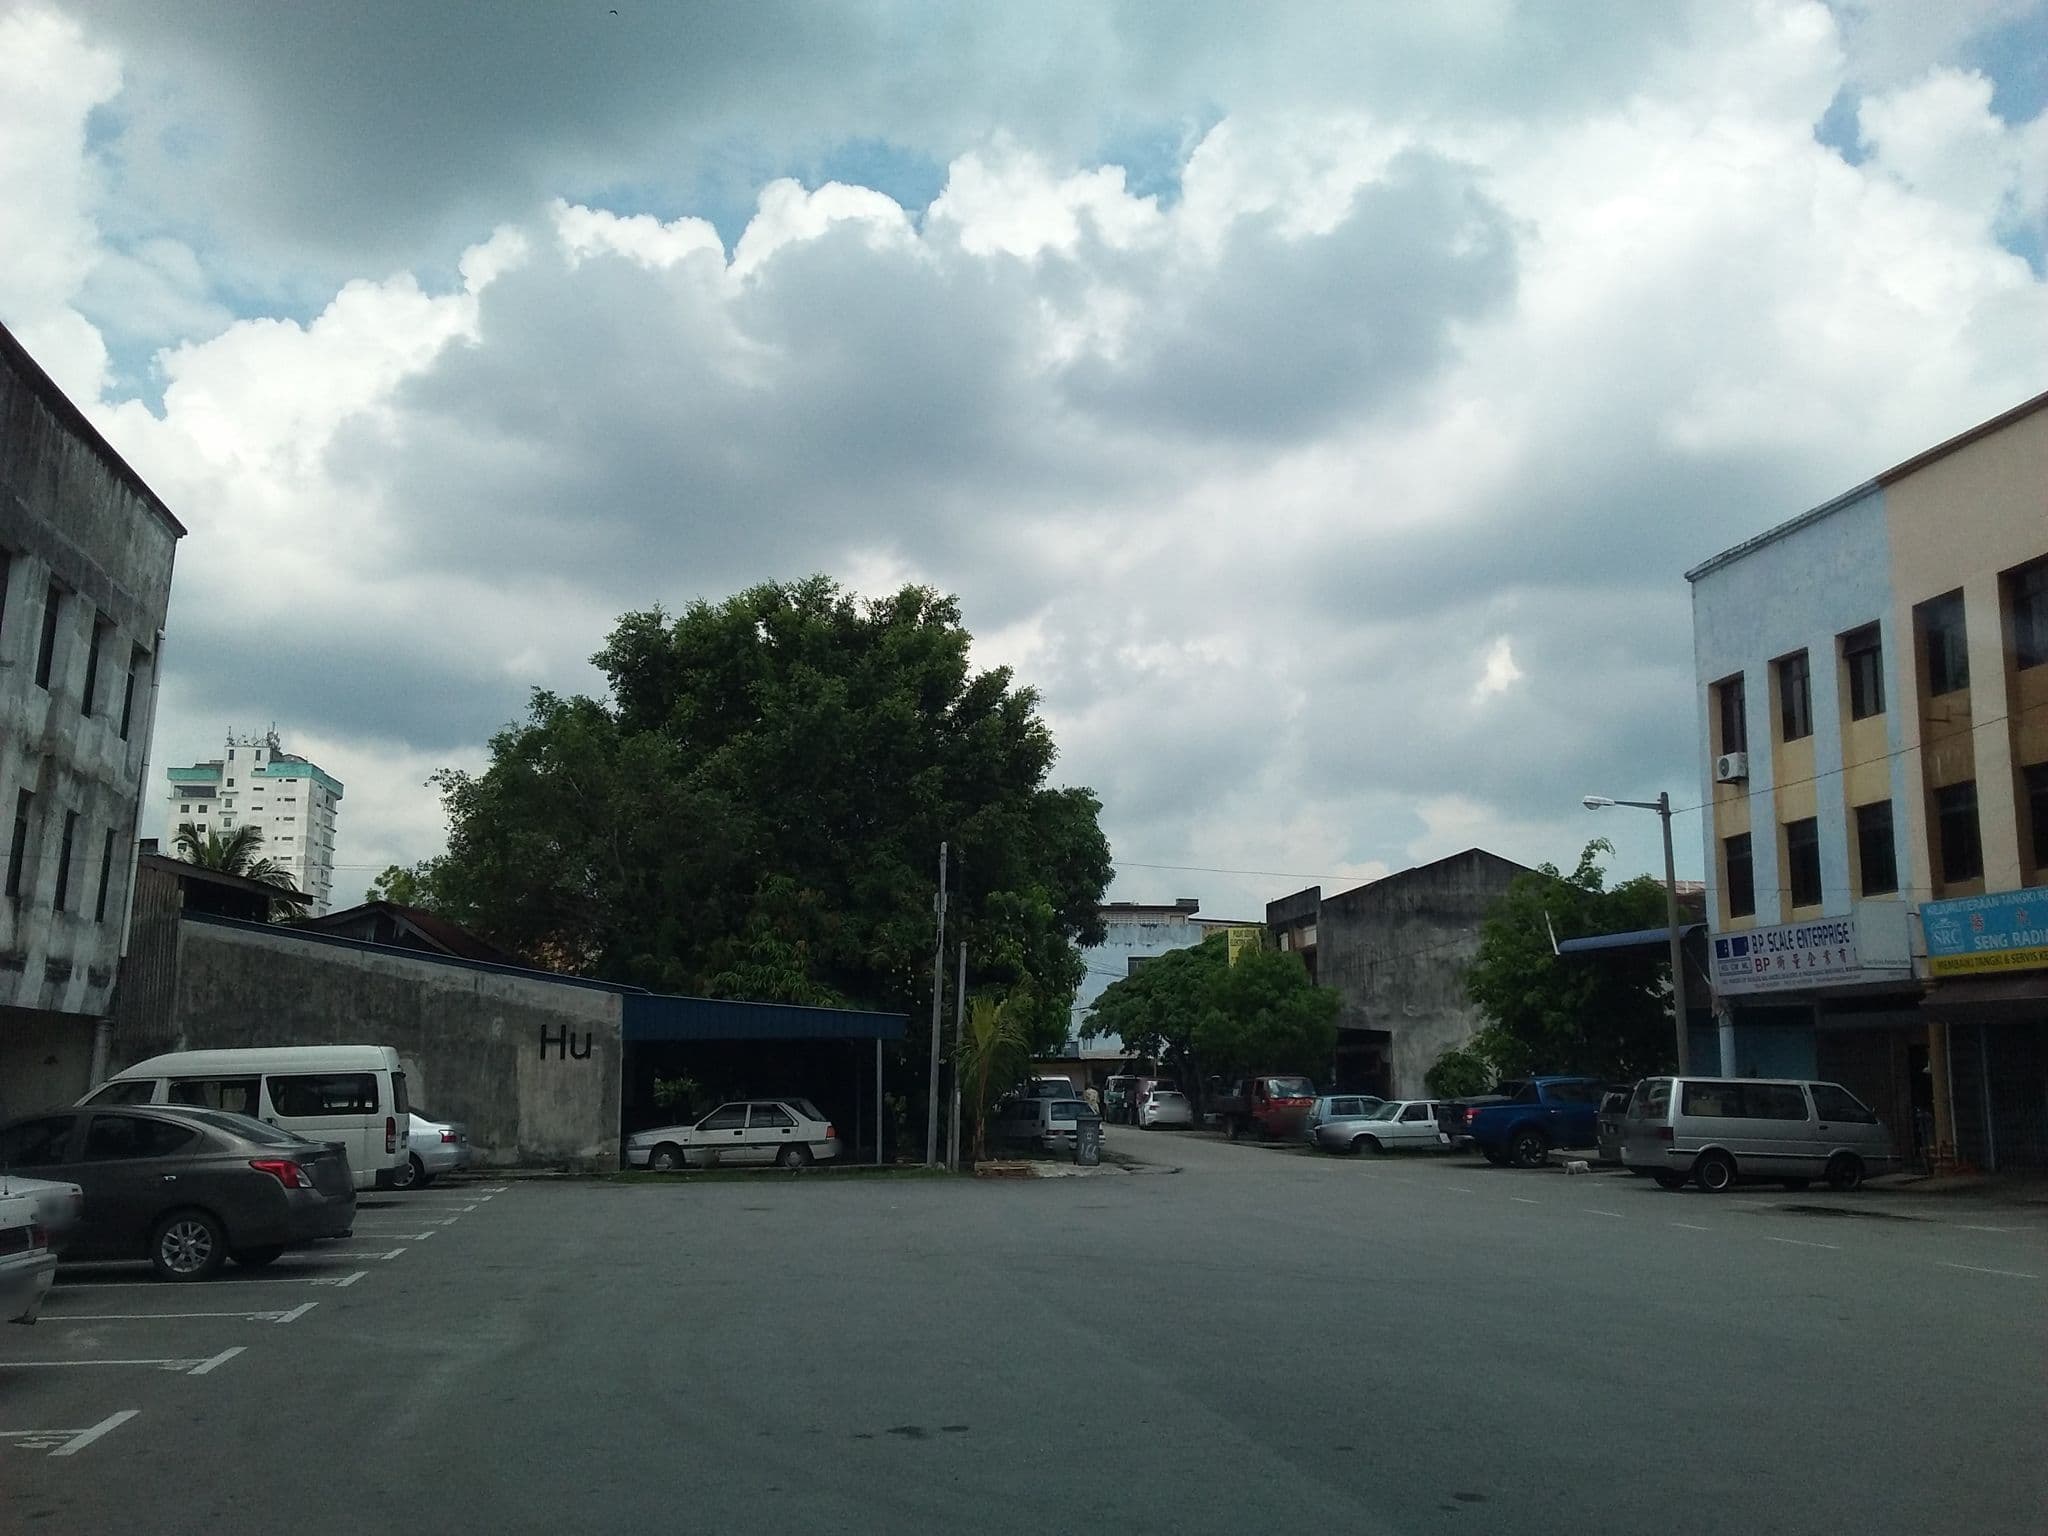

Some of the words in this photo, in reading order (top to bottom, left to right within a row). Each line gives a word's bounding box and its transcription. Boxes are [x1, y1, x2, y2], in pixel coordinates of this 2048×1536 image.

[2001, 891, 2036, 905] TANGKI
[1768, 930, 1795, 952] SCALE
[1797, 922, 1850, 949] ENTERPRISE
[1974, 934, 2009, 951] SENG
[1754, 957, 1770, 973] BP
[540, 1023, 592, 1062] Hu
